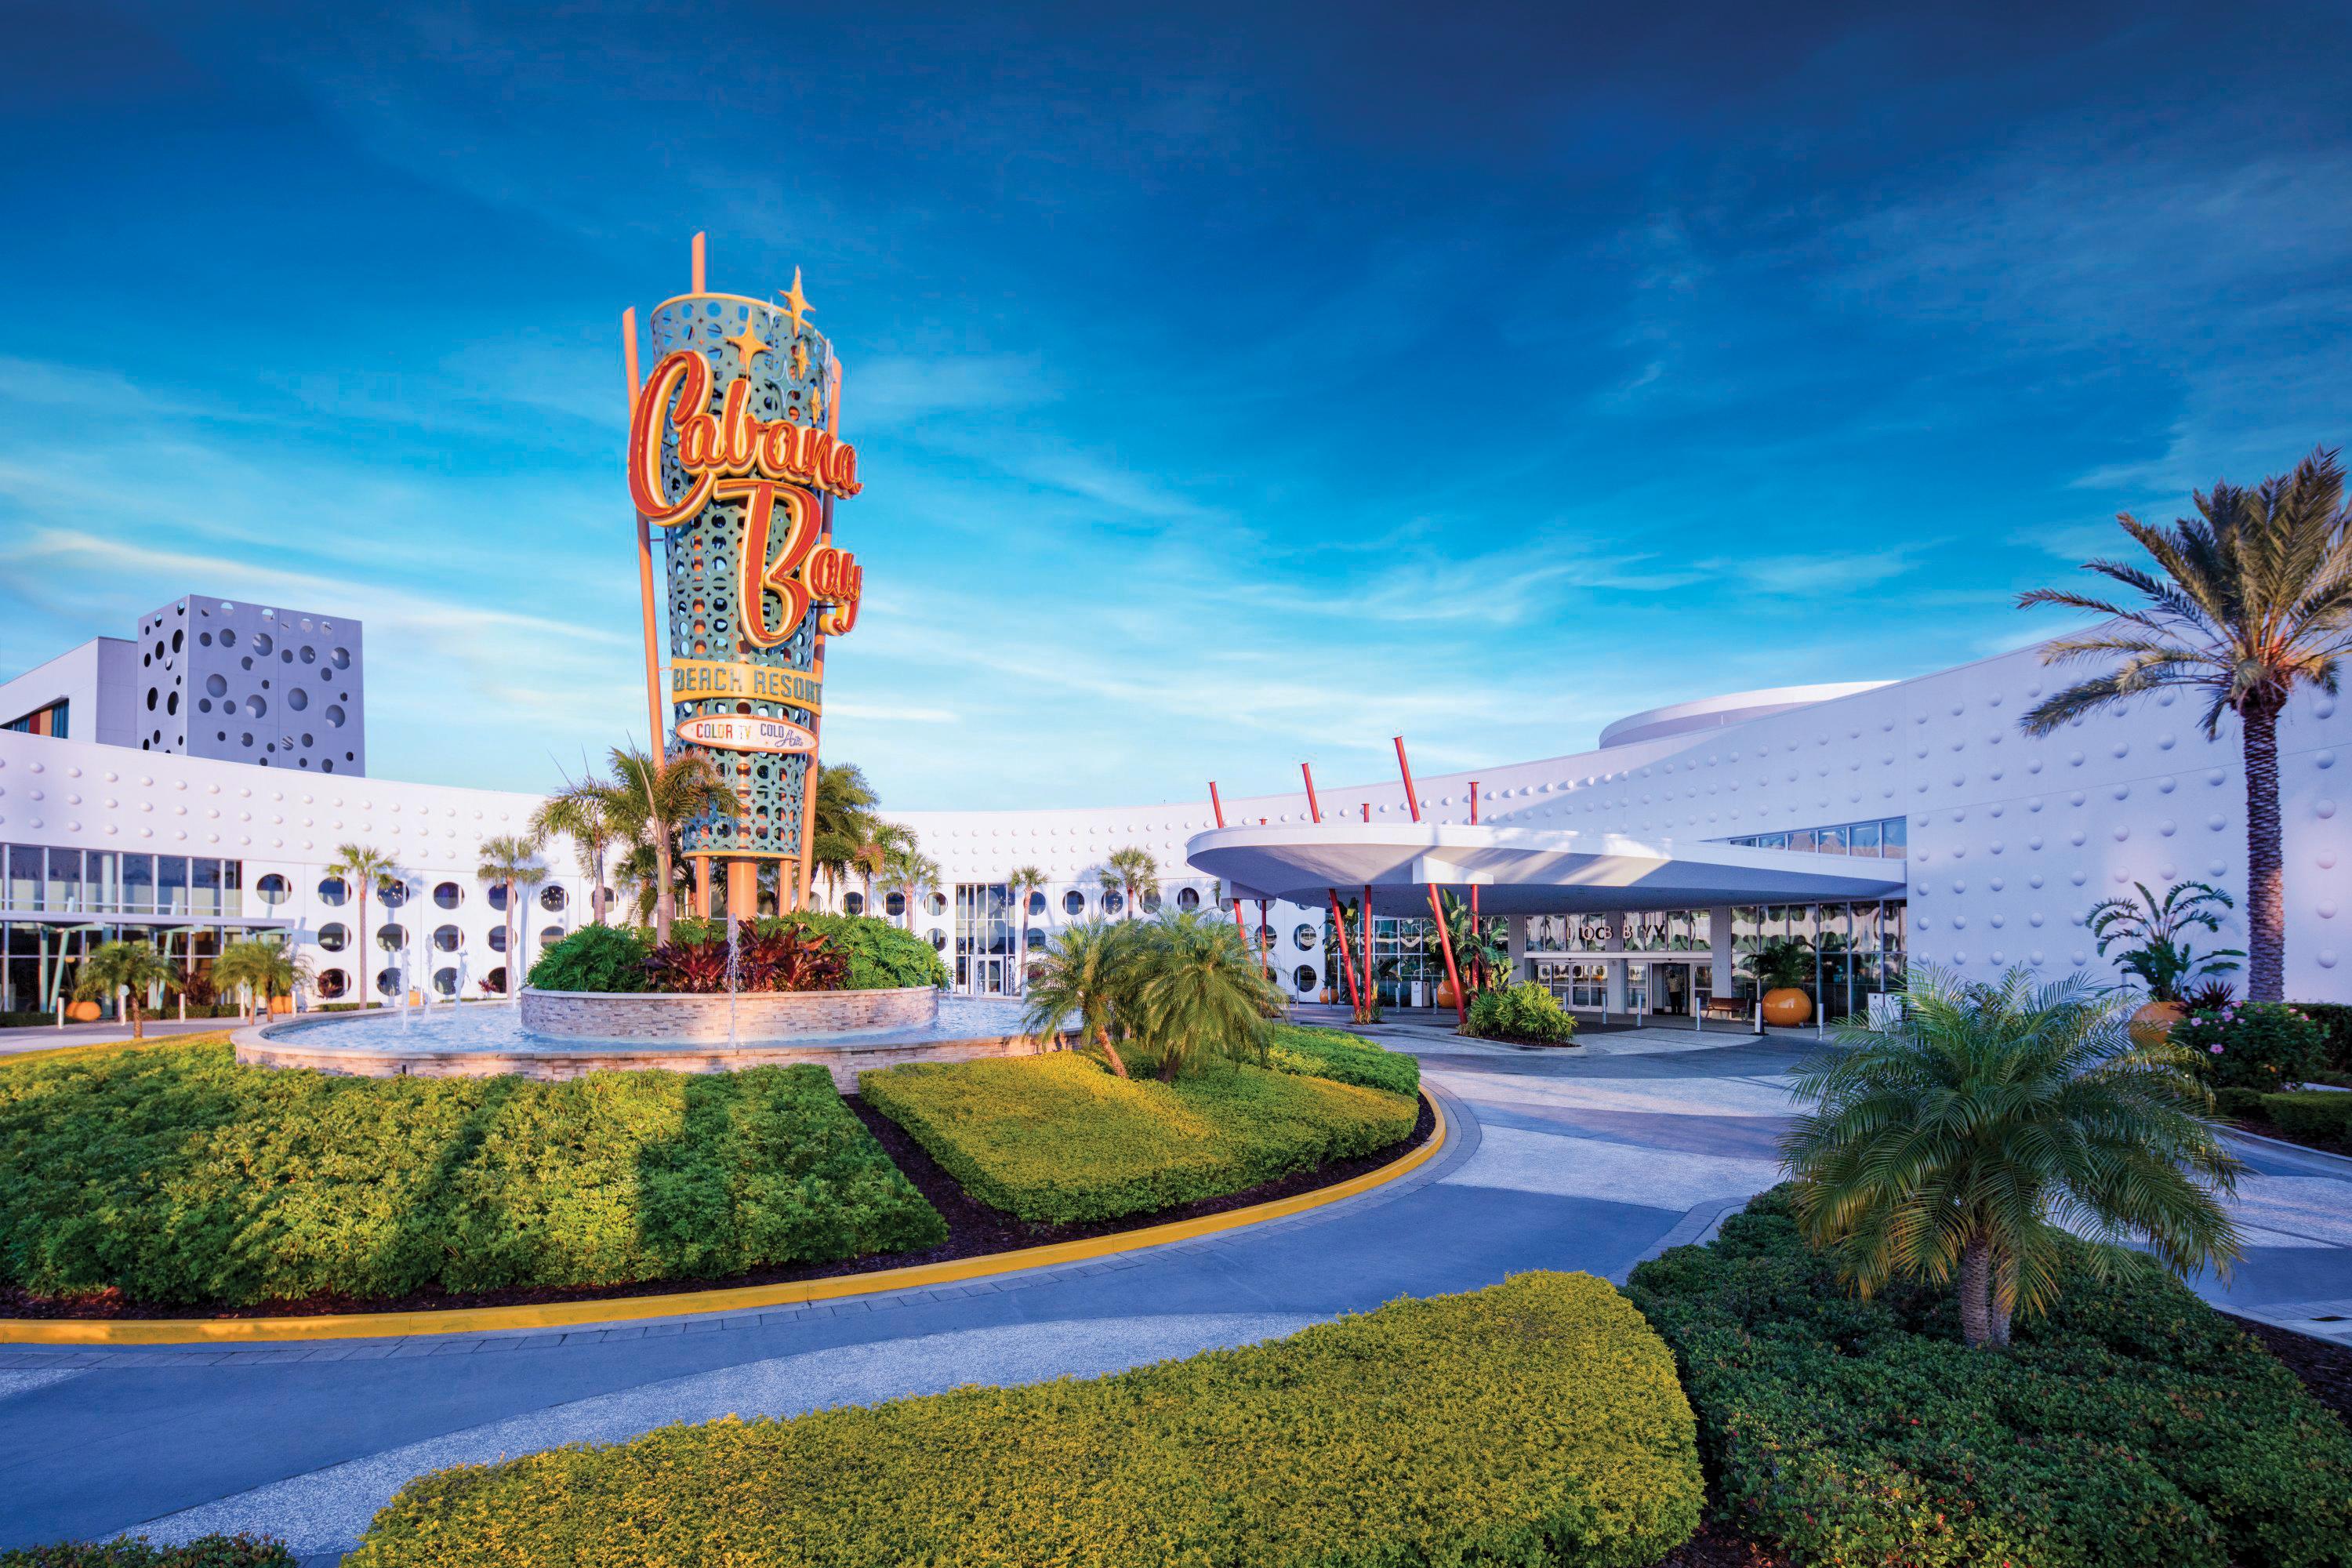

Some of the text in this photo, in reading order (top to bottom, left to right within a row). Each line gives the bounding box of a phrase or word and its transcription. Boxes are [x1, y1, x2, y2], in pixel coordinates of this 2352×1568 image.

[627, 350, 862, 526] Cabana
[713, 478, 862, 649] Bay
[673, 666, 822, 706] BEACH RESORT
[696, 723, 733, 740] COLOR
[739, 725, 751, 740] TV
[760, 723, 784, 739] COLD
